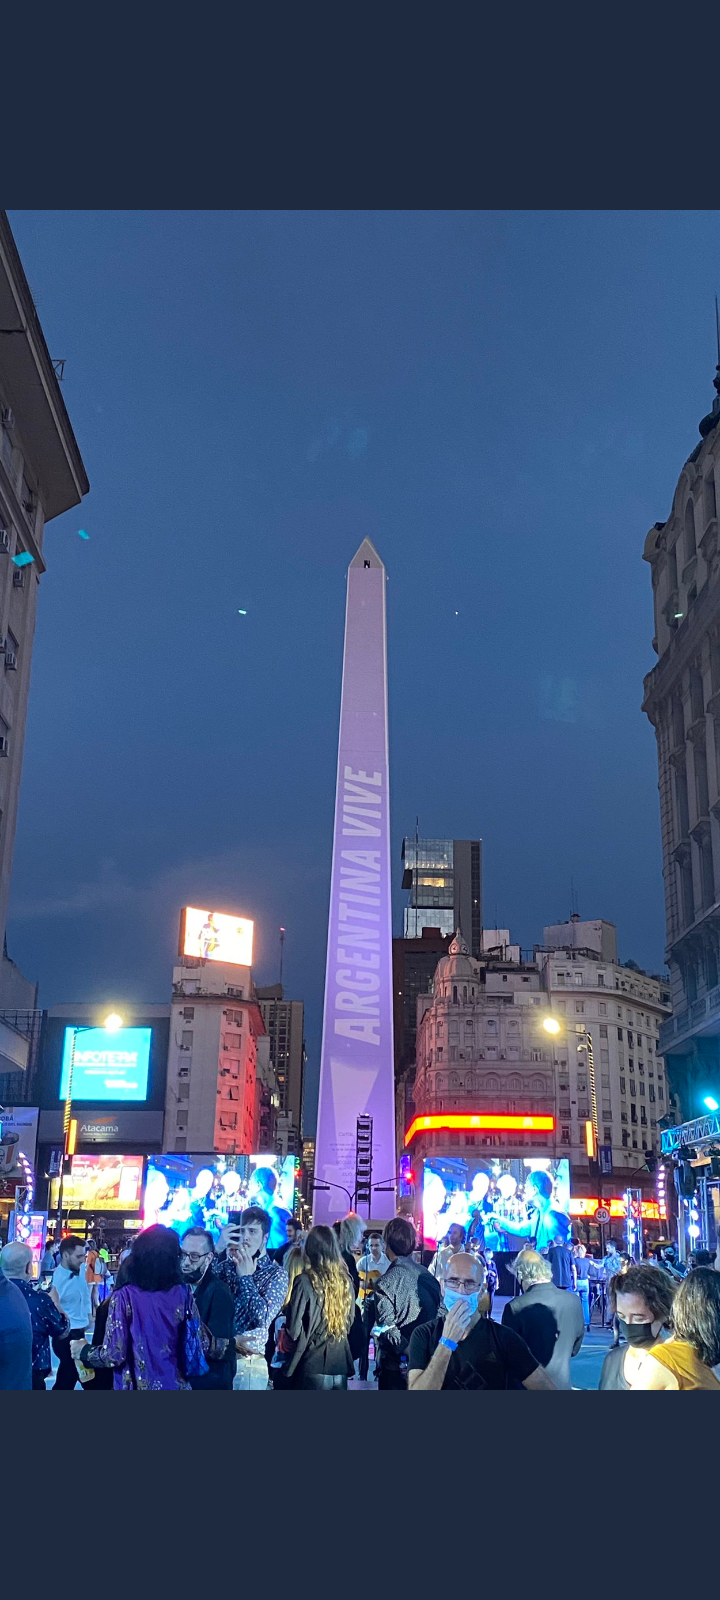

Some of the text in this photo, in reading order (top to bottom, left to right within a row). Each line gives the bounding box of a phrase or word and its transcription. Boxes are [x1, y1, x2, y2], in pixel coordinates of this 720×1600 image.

[334, 765, 382, 1046] ARGENTINA VIVE
[80, 1124, 119, 1132] Atacama
